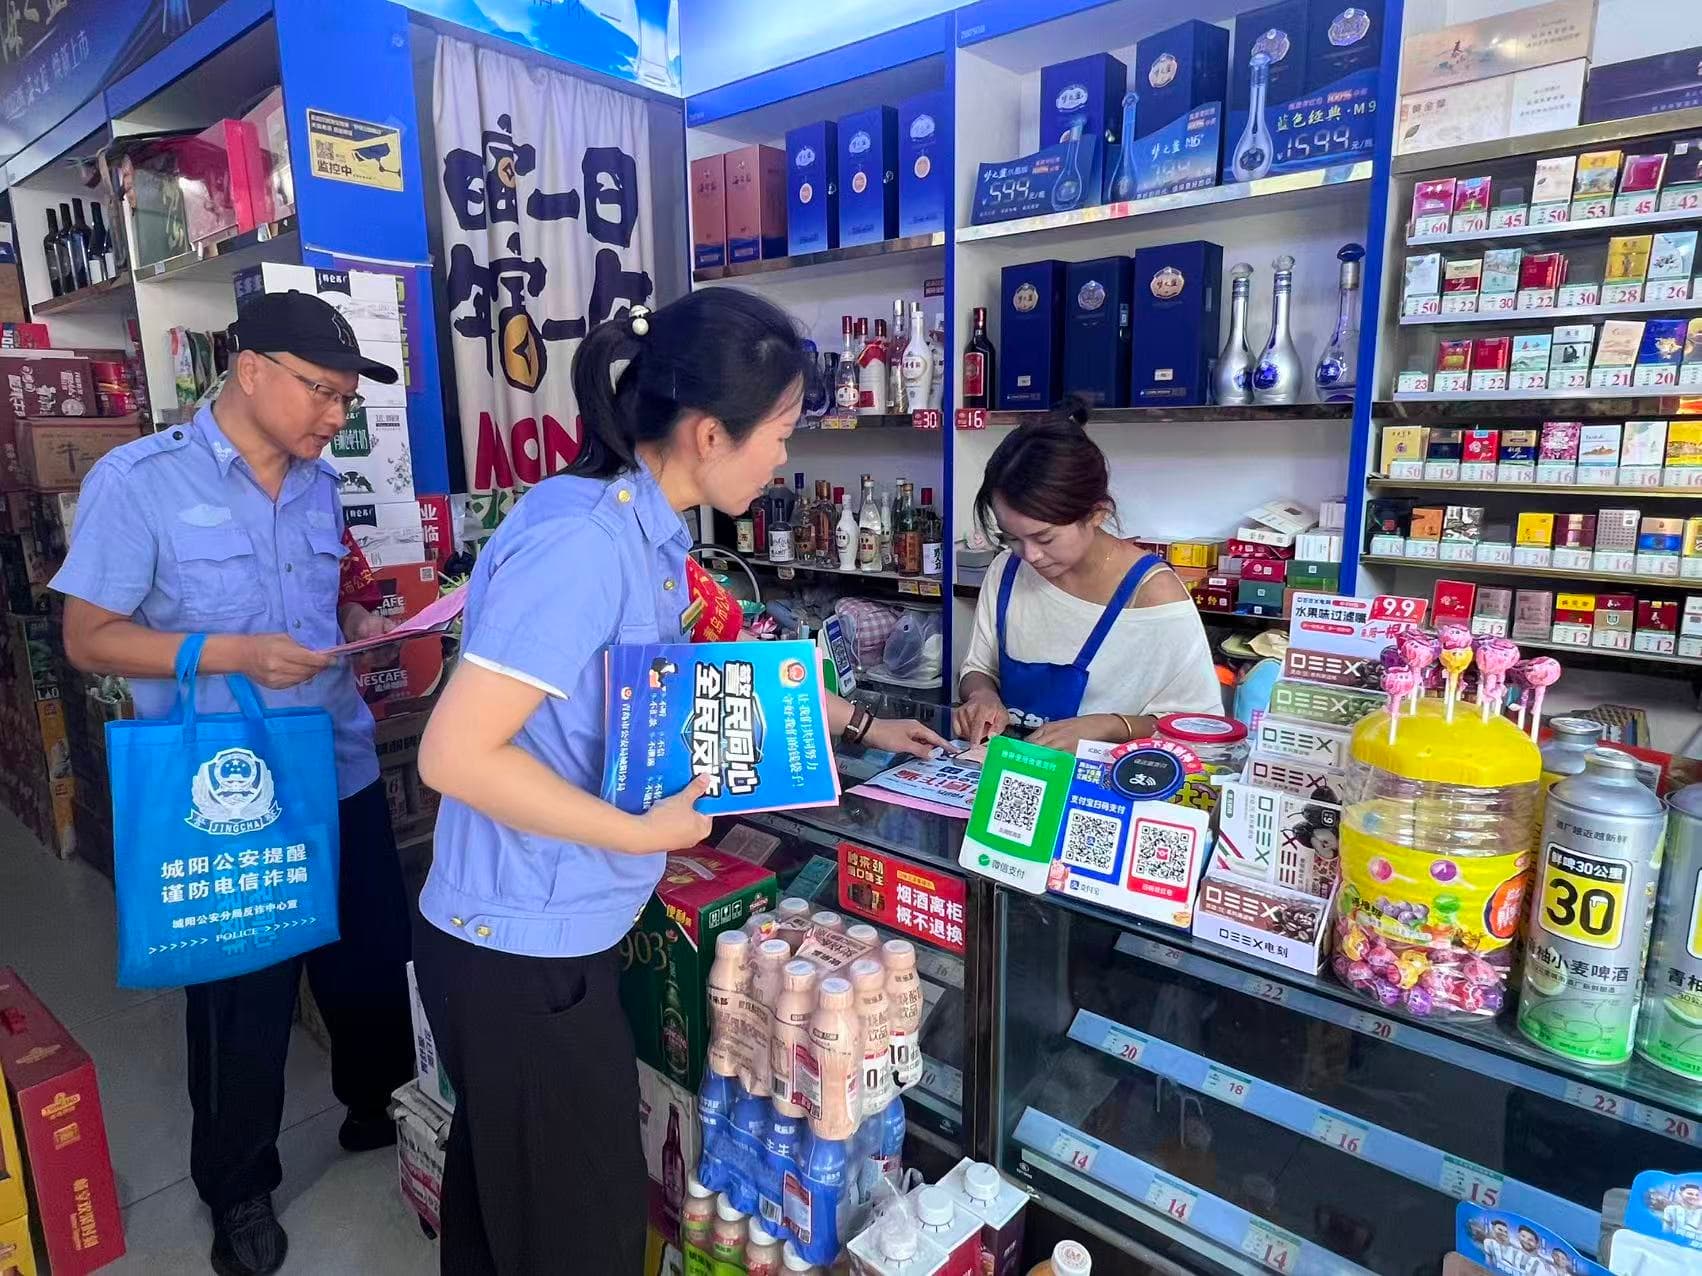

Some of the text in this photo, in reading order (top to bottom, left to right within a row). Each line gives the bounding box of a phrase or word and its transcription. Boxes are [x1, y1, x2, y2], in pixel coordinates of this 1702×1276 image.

[318, 160, 352, 176] 监控中
[1635, 201, 1651, 215] 45
[1679, 195, 1698, 209] 42
[1549, 208, 1566, 222] 50
[1587, 206, 1606, 217] 53
[1431, 221, 1447, 234] 60
[1467, 219, 1483, 232] 70
[1503, 214, 1523, 228] 45
[1579, 292, 1596, 306] 30
[1619, 289, 1638, 303] 28
[1667, 286, 1687, 299] 26
[1422, 302, 1438, 314] 50
[1459, 300, 1474, 312] 22
[1499, 297, 1513, 309] 30
[1536, 296, 1553, 308] 22
[1414, 379, 1428, 390] 23
[1451, 378, 1467, 391] 24
[1489, 377, 1505, 389] 22
[1527, 375, 1545, 388] 22
[1567, 374, 1585, 387] 22
[1612, 372, 1630, 386] 21
[1654, 371, 1674, 385] 20
[924, 411, 937, 428] 30
[967, 410, 983, 428] 16
[1407, 466, 1422, 479] 50
[1439, 466, 1454, 479] 19
[1478, 468, 1494, 481] 18
[1516, 469, 1532, 481] 18
[1639, 471, 1658, 486] 16
[1421, 545, 1437, 558] 22
[1494, 550, 1510, 563] 20
[1612, 556, 1632, 571] 16
[1382, 598, 1415, 617] 9.9
[1489, 623, 1503, 636] 12
[1571, 629, 1589, 644] 12
[1612, 631, 1628, 646] 11
[1655, 637, 1674, 652] 12
[691, 660, 722, 797] 全民反诈
[723, 659, 760, 794] 警民同心
[798, 693, 820, 771] 让我们共同努力
[1071, 794, 1127, 815] 支付宝扫码支付
[210, 818, 262, 834] JINGCHA
[160, 843, 308, 880] 城阳公安提醒
[1550, 851, 1624, 881] 鲜啤30公里
[991, 859, 1026, 880] 微信支付
[160, 866, 309, 904] 谨防电信诈骗
[896, 882, 964, 924] 烟酒离柜
[1546, 877, 1616, 936] 30
[172, 898, 299, 930] 城阳公安分局反诈中心宣
[896, 903, 963, 947] 概不退换
[215, 926, 259, 943] POLICE
[1262, 982, 1284, 1000] 22
[1372, 1022, 1392, 1039] 20
[1120, 1044, 1138, 1060] 20
[1228, 1082, 1244, 1095] 18
[1594, 1093, 1618, 1115] 22
[1664, 1117, 1691, 1139] 20
[1338, 1133, 1361, 1153] 16
[1071, 1150, 1089, 1169] 14
[1469, 1181, 1497, 1207] 15
[1167, 1198, 1187, 1217] 14
[1262, 1243, 1289, 1272] 14
